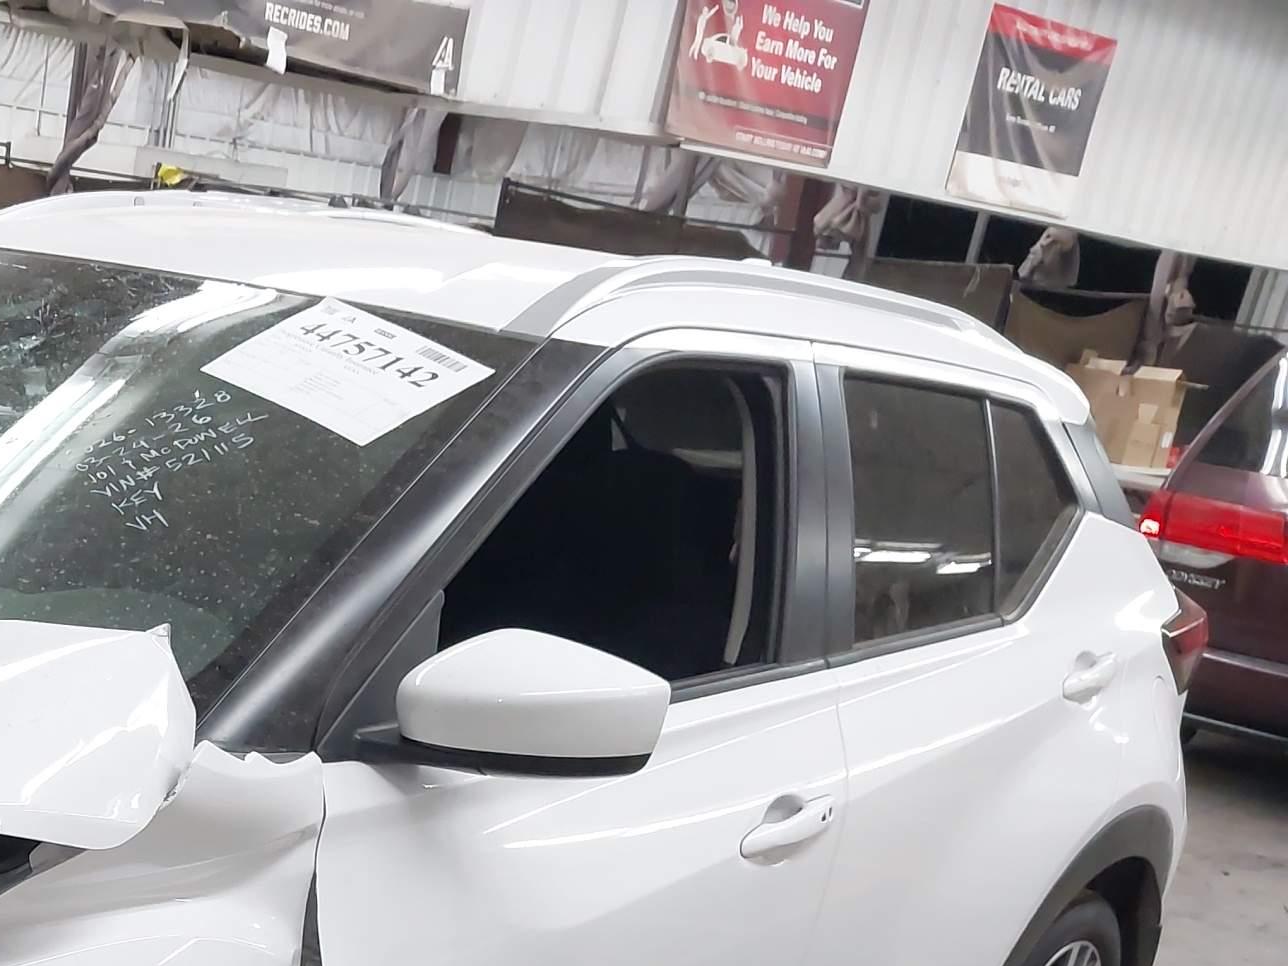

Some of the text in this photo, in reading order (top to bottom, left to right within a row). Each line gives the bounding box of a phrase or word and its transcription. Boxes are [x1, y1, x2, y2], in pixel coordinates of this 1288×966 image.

[265, 2, 351, 41] RECRIDES.COM
[762, 4, 834, 43] We Help You
[755, 31, 838, 70] Earn More For
[751, 57, 822, 93] Your Vehicle
[997, 67, 1082, 110] RENTAL CARS
[300, 323, 440, 387] 44757142
[112, 481, 163, 515] KEY
